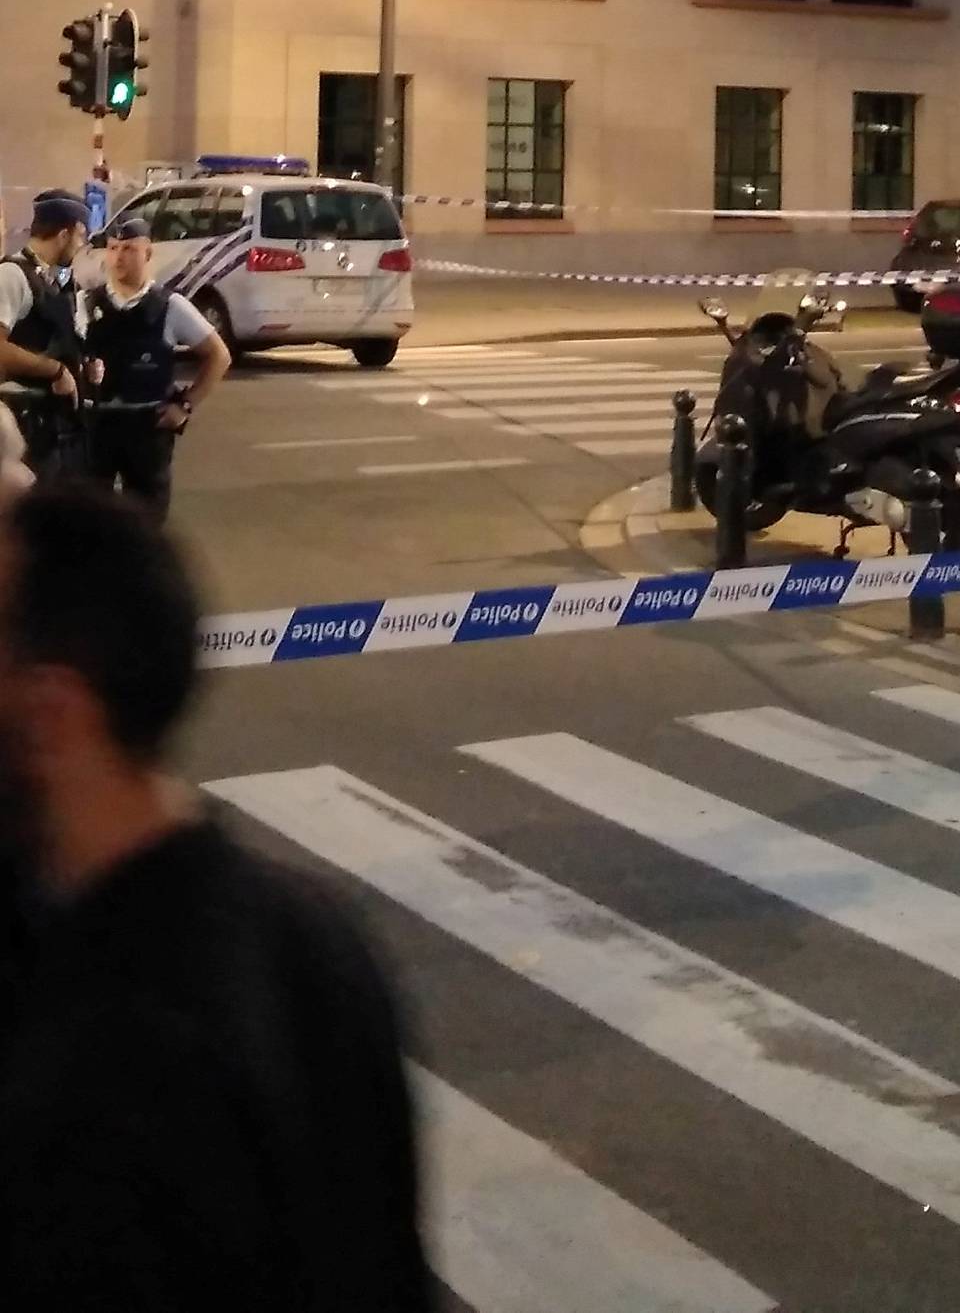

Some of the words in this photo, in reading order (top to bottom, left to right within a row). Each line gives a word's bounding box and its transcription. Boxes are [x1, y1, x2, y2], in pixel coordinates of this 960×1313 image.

[786, 577, 830, 596] Police
[855, 570, 904, 587] Politie
[633, 588, 681, 609] Police
[709, 581, 760, 601] Politie
[470, 604, 519, 626] Police
[551, 594, 605, 615] Politie
[380, 611, 438, 634] Politie
[293, 622, 345, 645] Police
